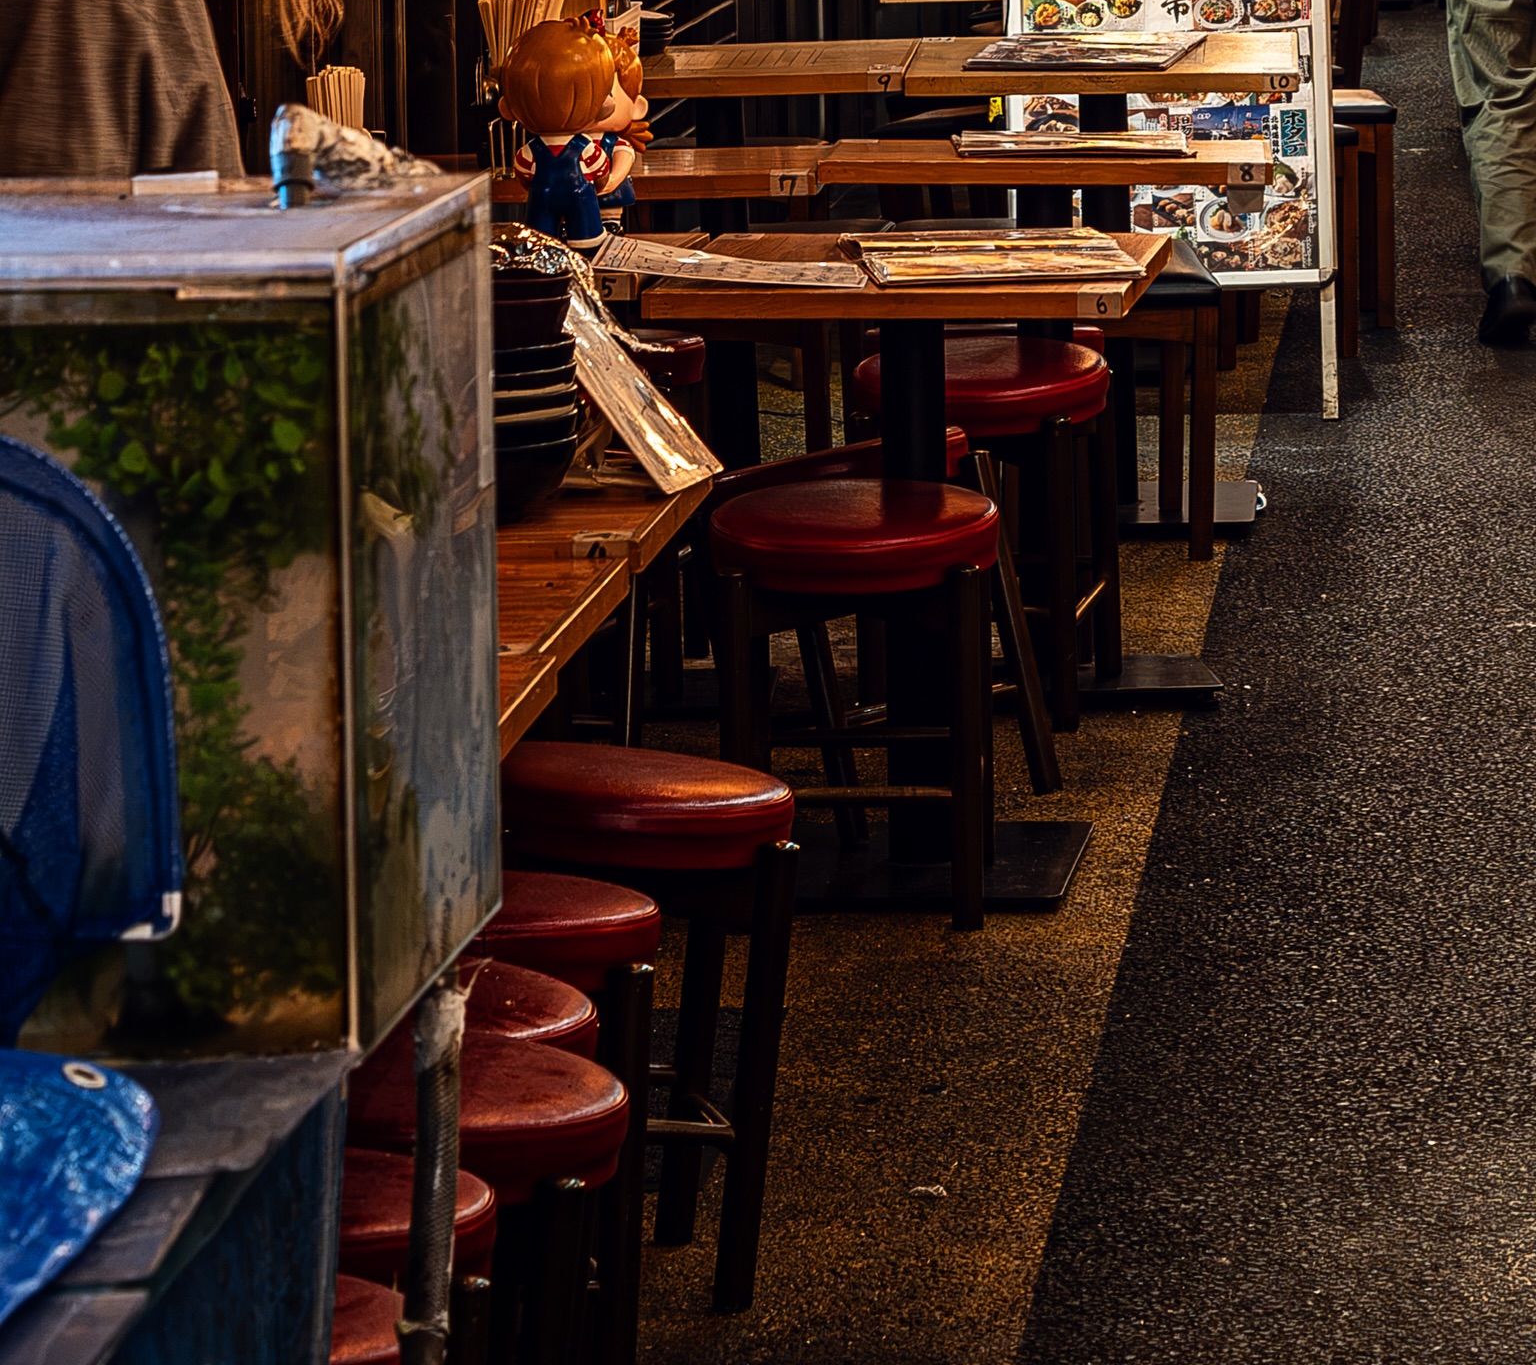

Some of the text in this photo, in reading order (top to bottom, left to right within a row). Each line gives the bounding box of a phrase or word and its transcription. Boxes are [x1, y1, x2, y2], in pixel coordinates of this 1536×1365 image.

[876, 74, 891, 92] 9
[1269, 73, 1291, 90] 10
[1283, 110, 1307, 156] ホタテ
[1239, 162, 1254, 183] 8
[778, 173, 797, 197] 7
[601, 276, 617, 298] 5
[1095, 294, 1109, 313] 6
